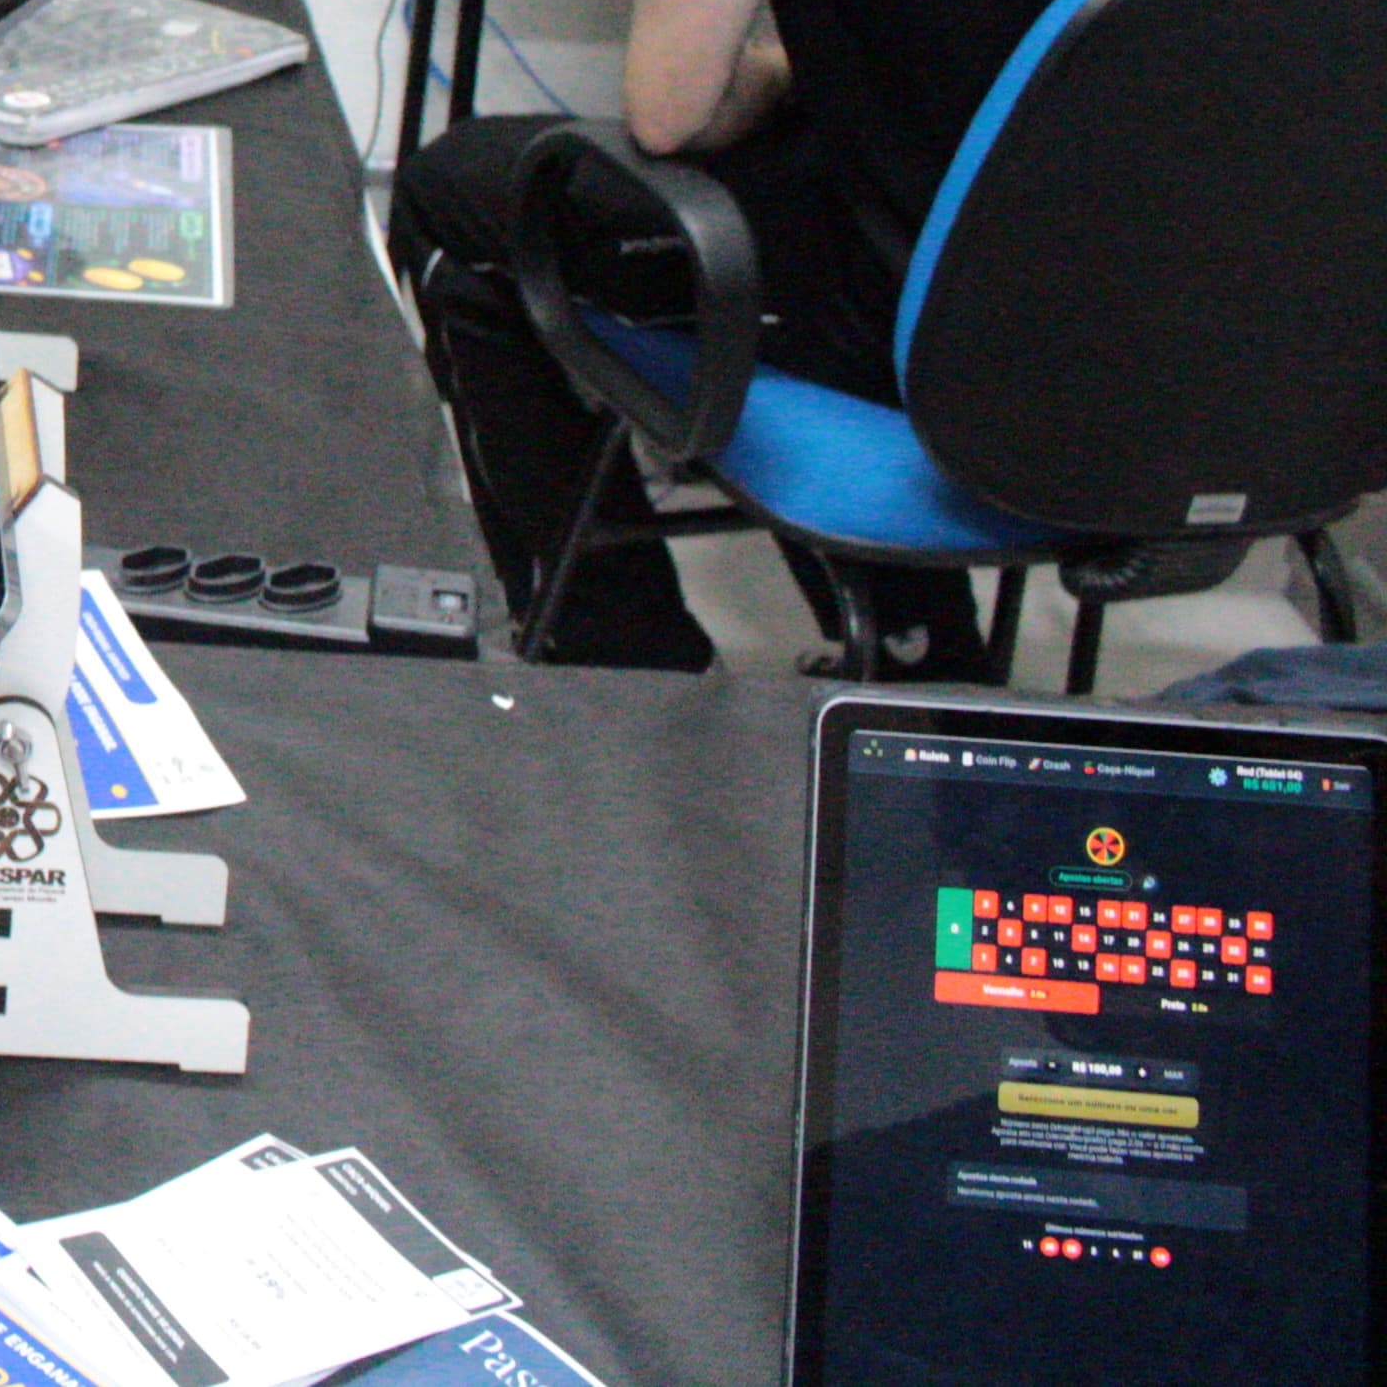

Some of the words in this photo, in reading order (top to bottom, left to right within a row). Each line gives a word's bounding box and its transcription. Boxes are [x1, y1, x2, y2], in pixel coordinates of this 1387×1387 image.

[1160, 998, 1187, 1012] Preto
[1072, 1060, 1086, 1073] R$
[4, 1333, 84, 1387] ENGANA
[459, 1329, 541, 1387] Pas
